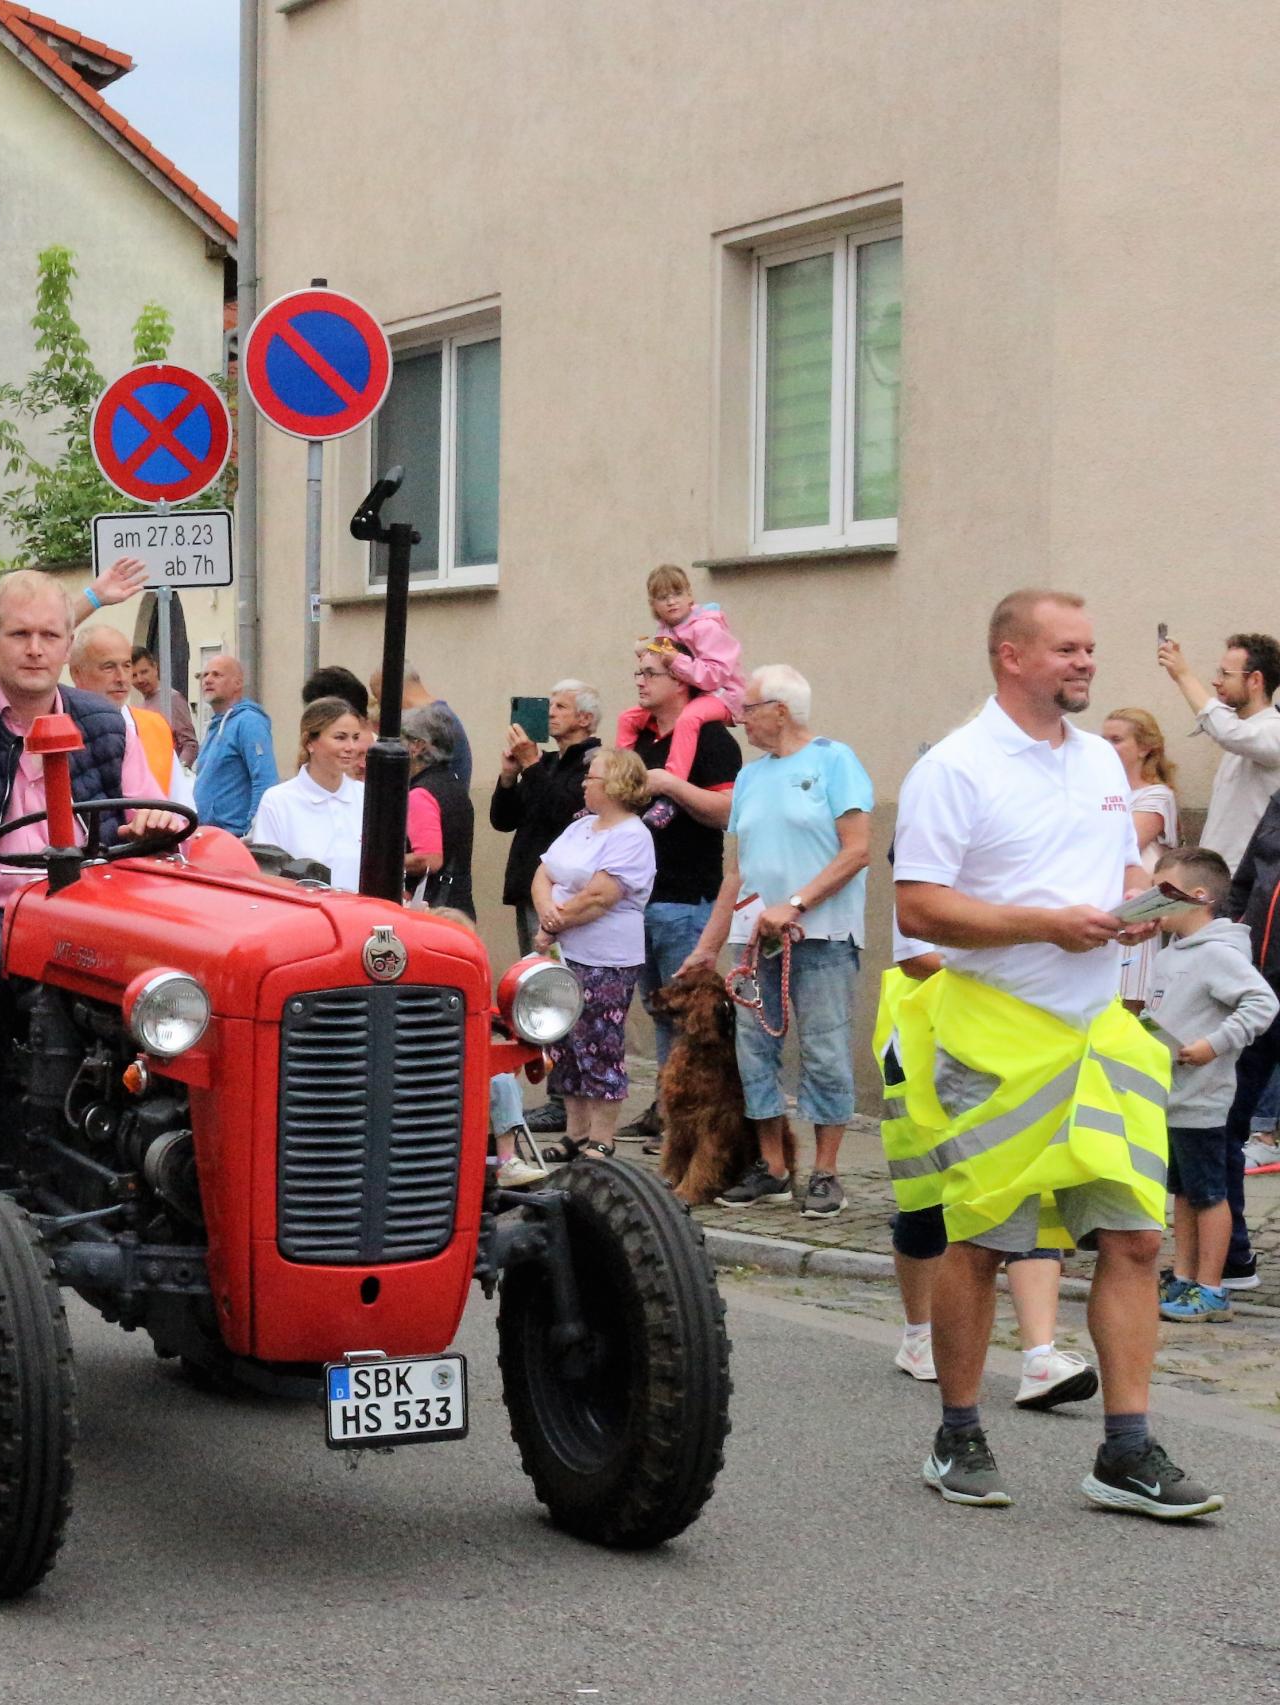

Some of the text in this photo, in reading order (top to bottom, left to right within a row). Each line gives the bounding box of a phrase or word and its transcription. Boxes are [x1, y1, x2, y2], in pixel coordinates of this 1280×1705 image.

[113, 524, 214, 548] am 27.8.23
[165, 554, 214, 577] ab 7h
[336, 1366, 413, 1400] D SBK
[342, 1397, 451, 1435] HS 533
